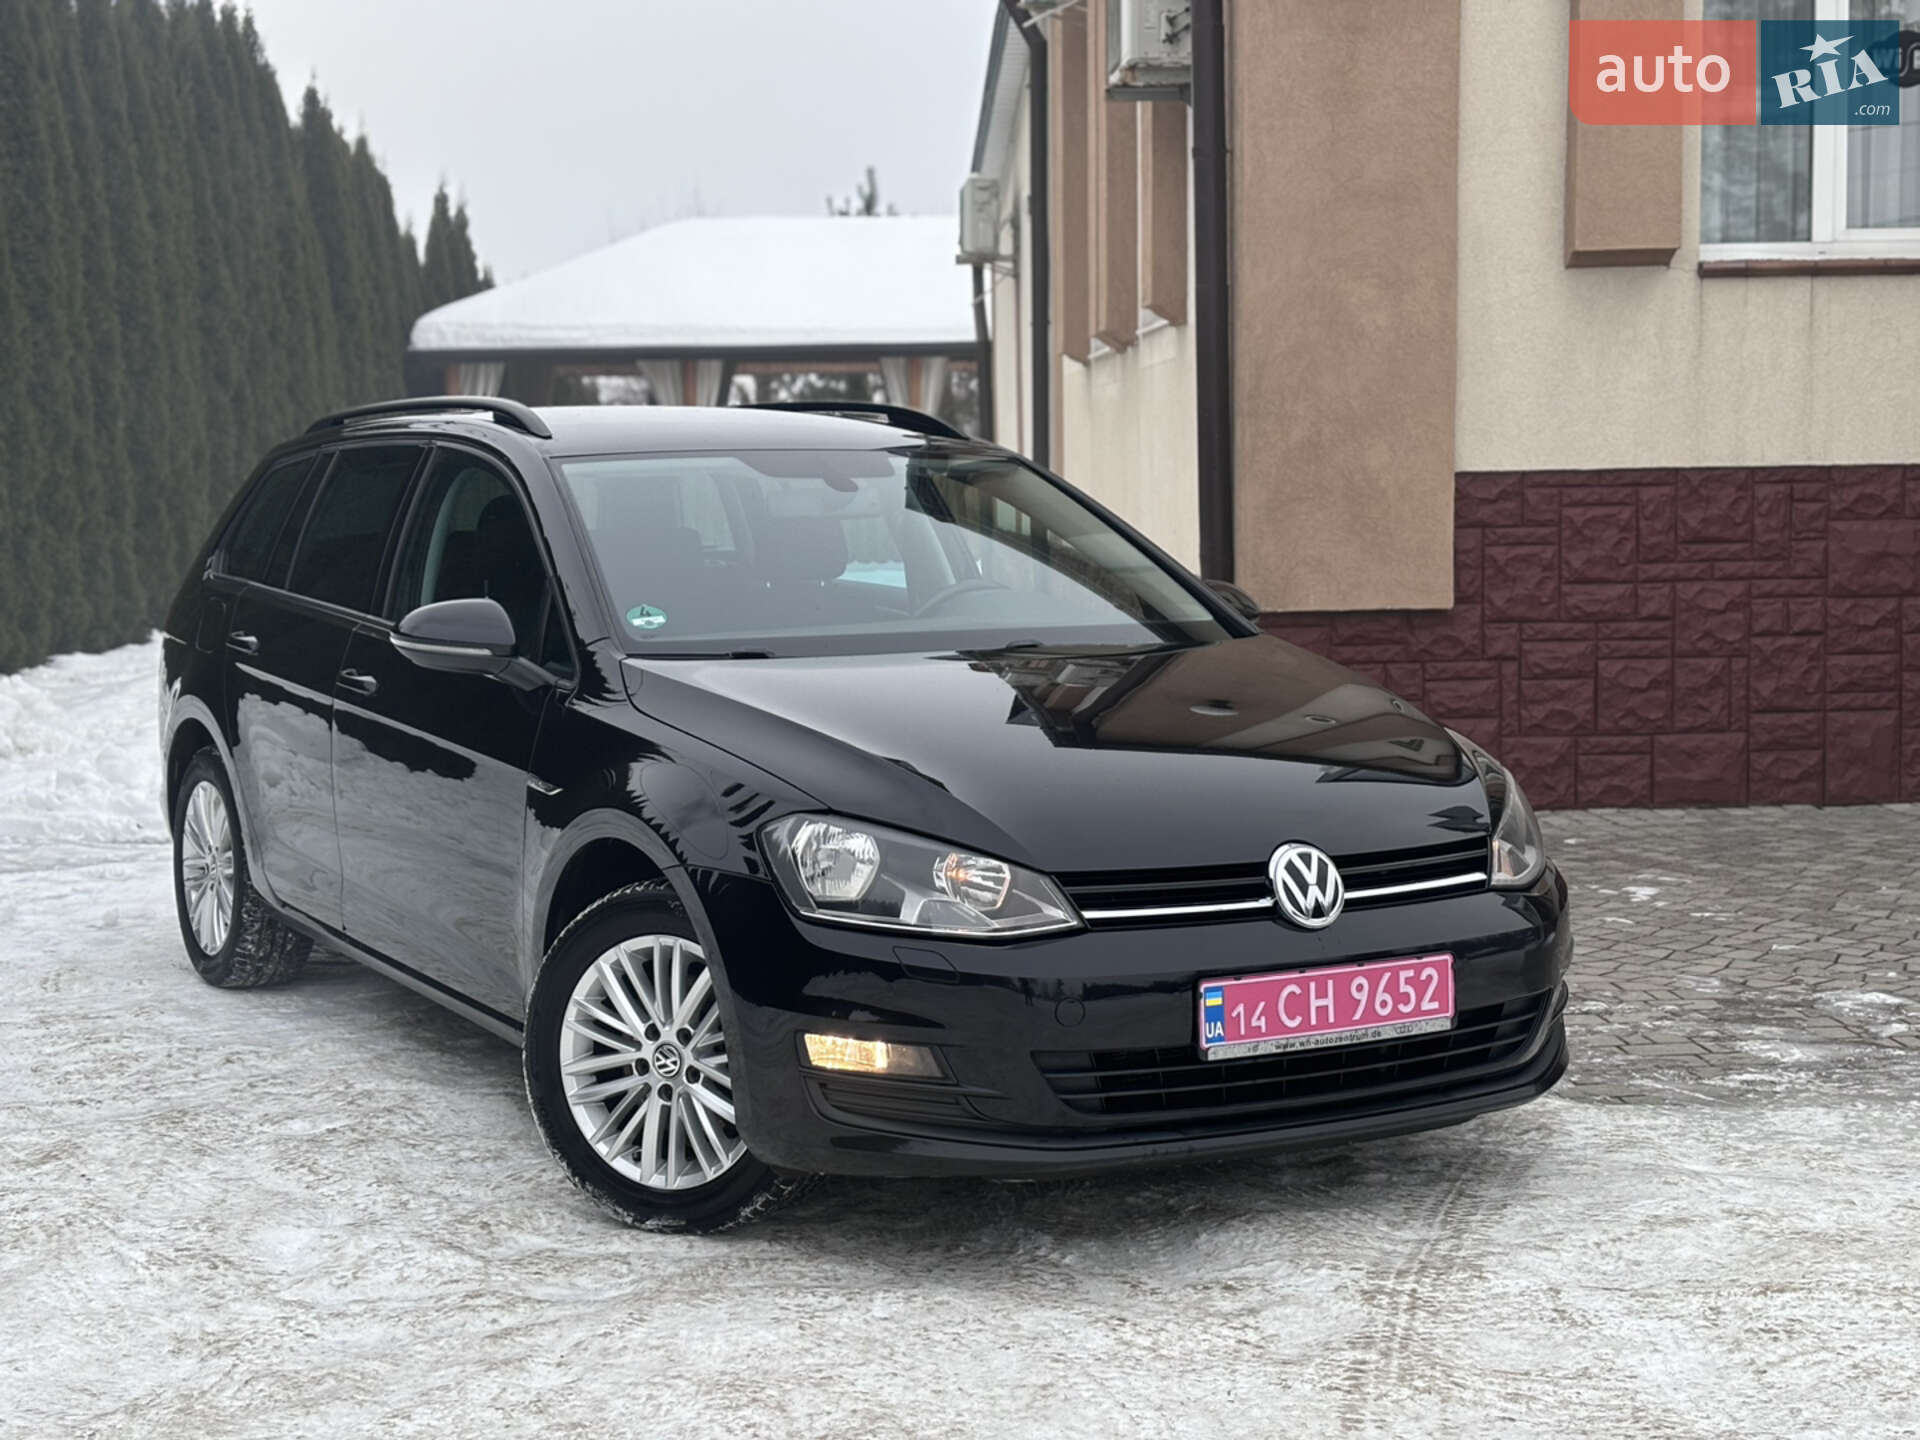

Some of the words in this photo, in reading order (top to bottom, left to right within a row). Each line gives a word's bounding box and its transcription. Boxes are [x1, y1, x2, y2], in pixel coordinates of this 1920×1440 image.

[1275, 846, 1344, 928] VW
[1205, 1021, 1225, 1039] UA
[1231, 1001, 1267, 1036] 14
[1277, 979, 1336, 1029] CH
[1350, 966, 1440, 1021] 9652
